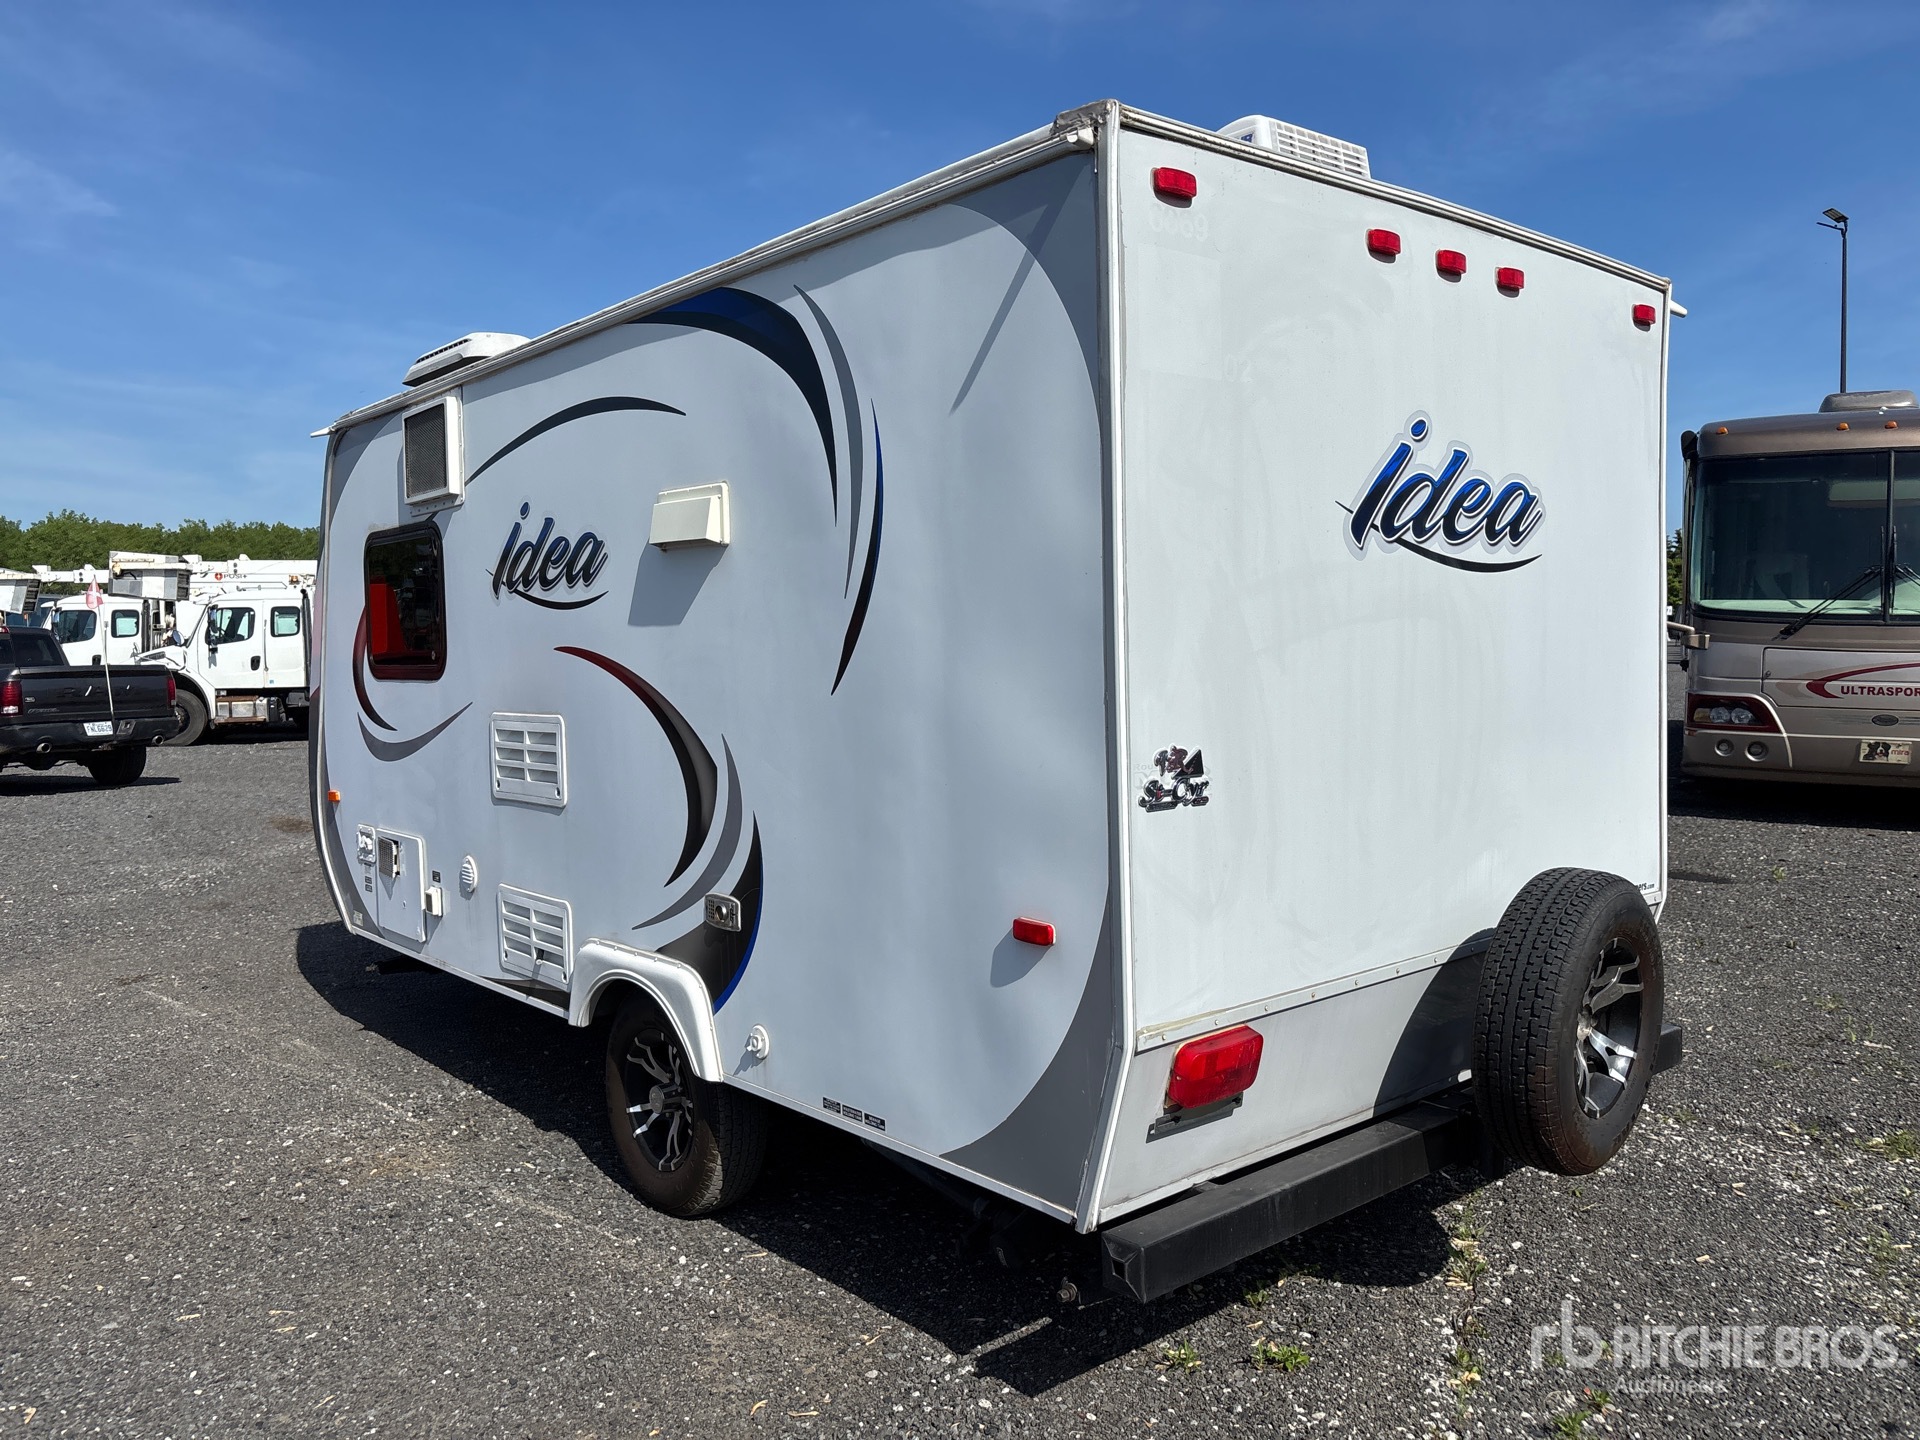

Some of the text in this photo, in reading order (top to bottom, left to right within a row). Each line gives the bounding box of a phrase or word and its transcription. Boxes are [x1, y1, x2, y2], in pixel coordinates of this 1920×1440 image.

[1350, 418, 1543, 551] idea
[492, 502, 608, 600] idea
[1890, 748, 1910, 756] mira
